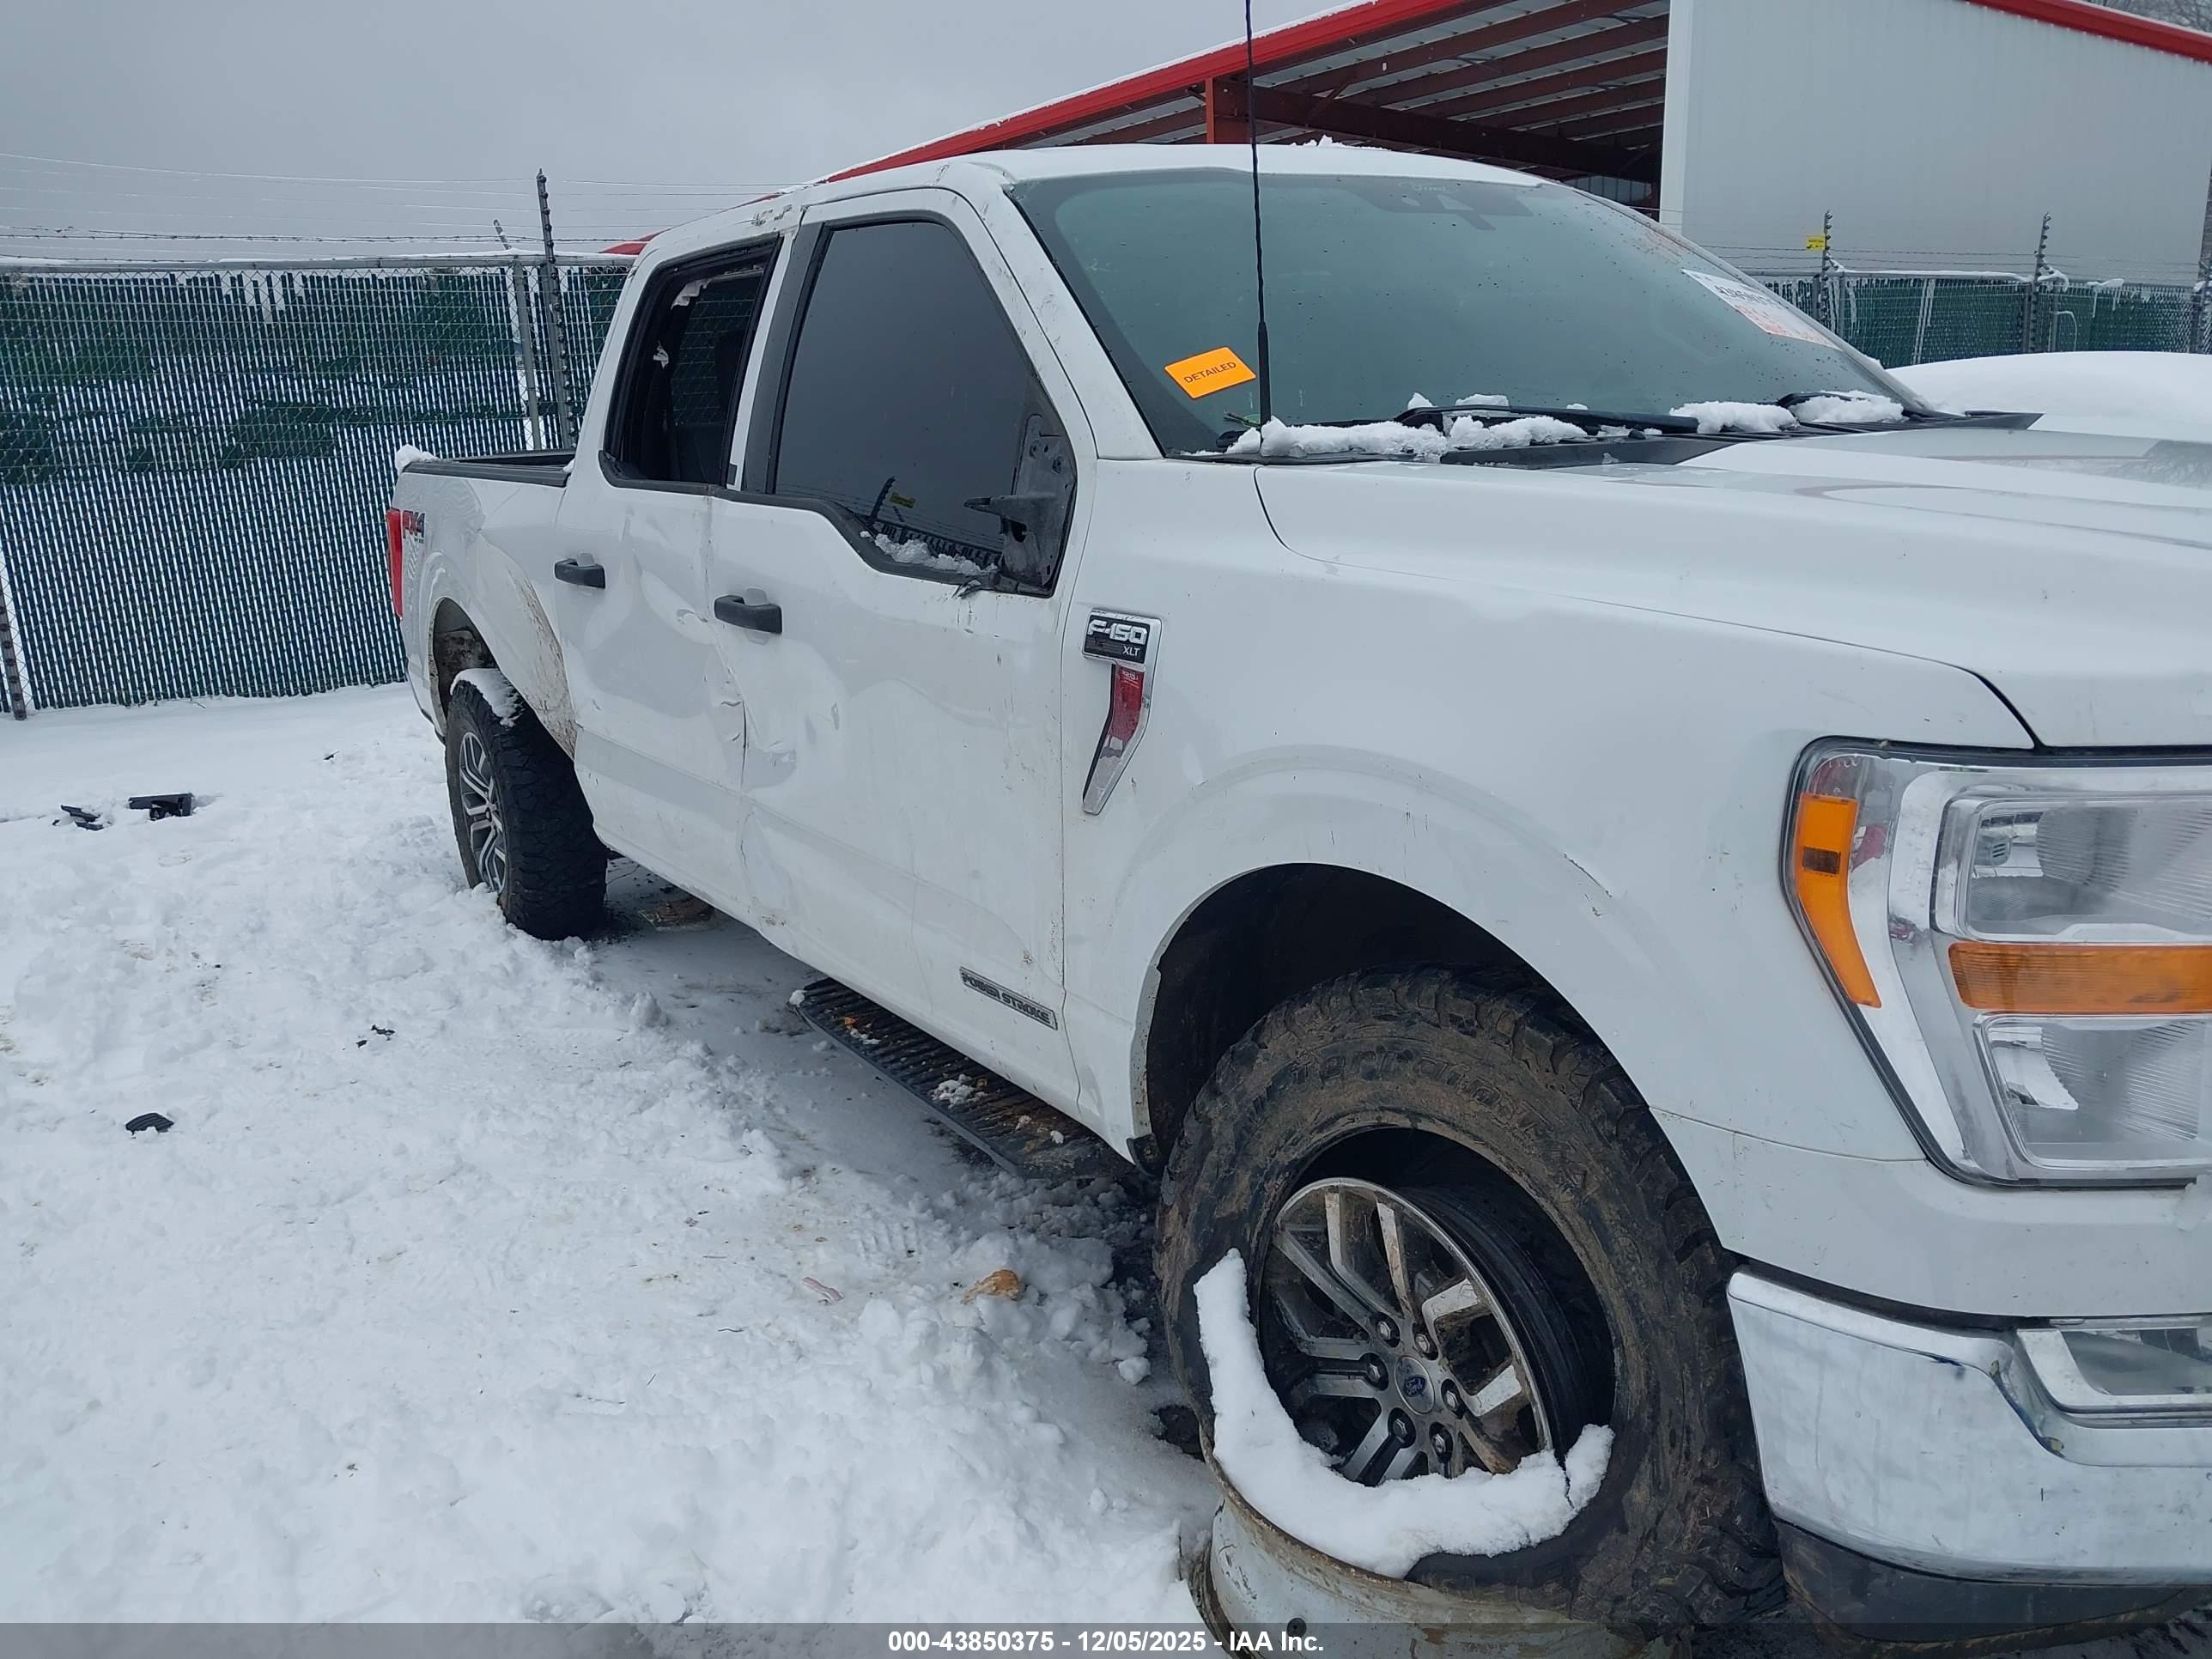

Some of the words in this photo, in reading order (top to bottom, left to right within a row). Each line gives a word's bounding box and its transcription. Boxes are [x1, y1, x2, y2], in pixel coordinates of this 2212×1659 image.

[1183, 362, 1237, 383] DETAILED
[1087, 619, 1147, 645] F-150
[1122, 646, 1140, 657] XLT
[961, 971, 1001, 1000] POWER
[1001, 992, 1050, 1024] STROKE
[1405, 1376, 1425, 1396] Ford
